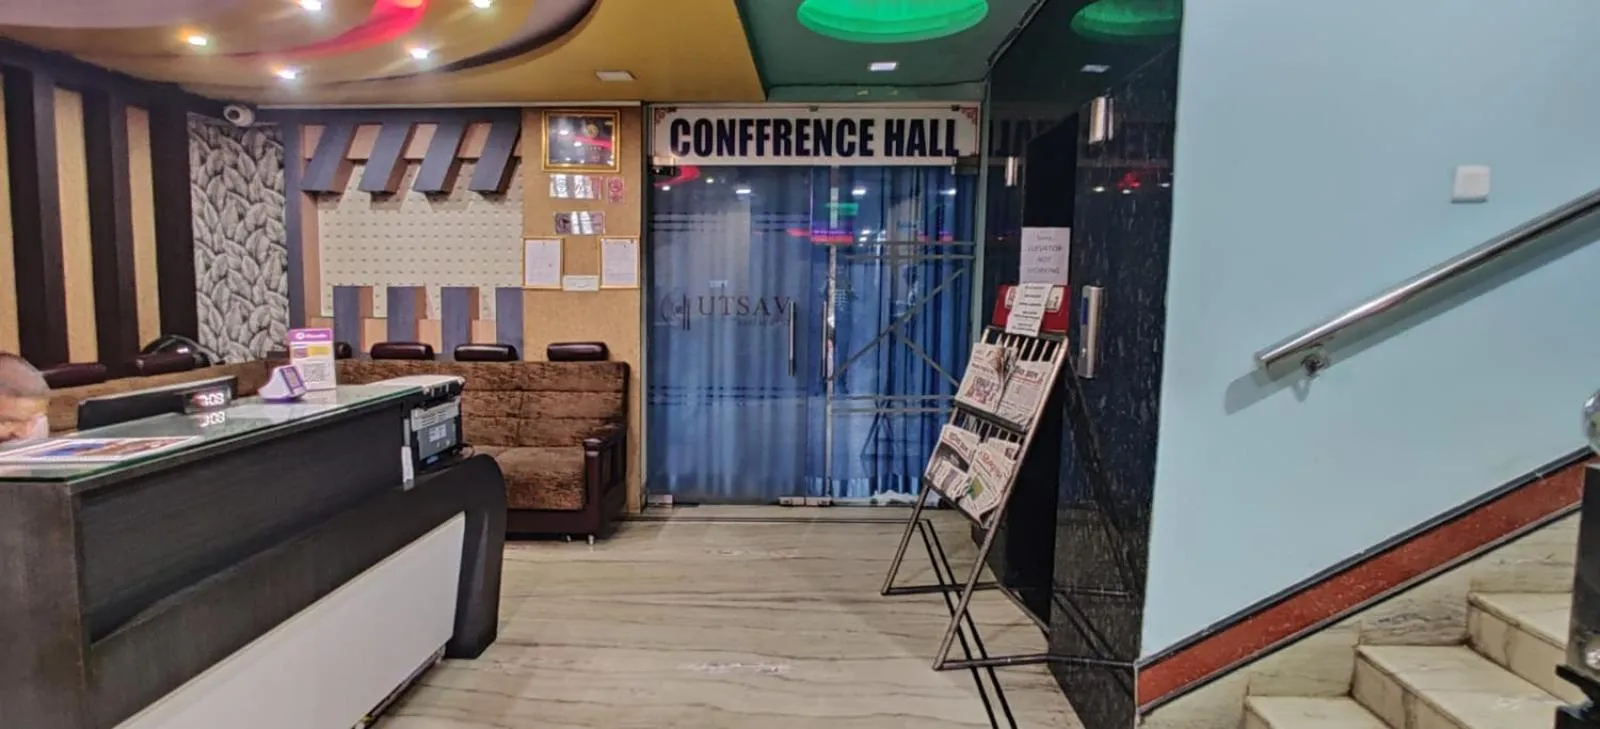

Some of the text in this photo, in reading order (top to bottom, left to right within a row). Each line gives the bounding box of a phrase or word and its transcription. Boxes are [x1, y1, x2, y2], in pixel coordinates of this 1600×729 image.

[670, 118, 875, 158] CONFFRENCE
[883, 118, 960, 158] HALL
[698, 295, 790, 316] UTSAV
